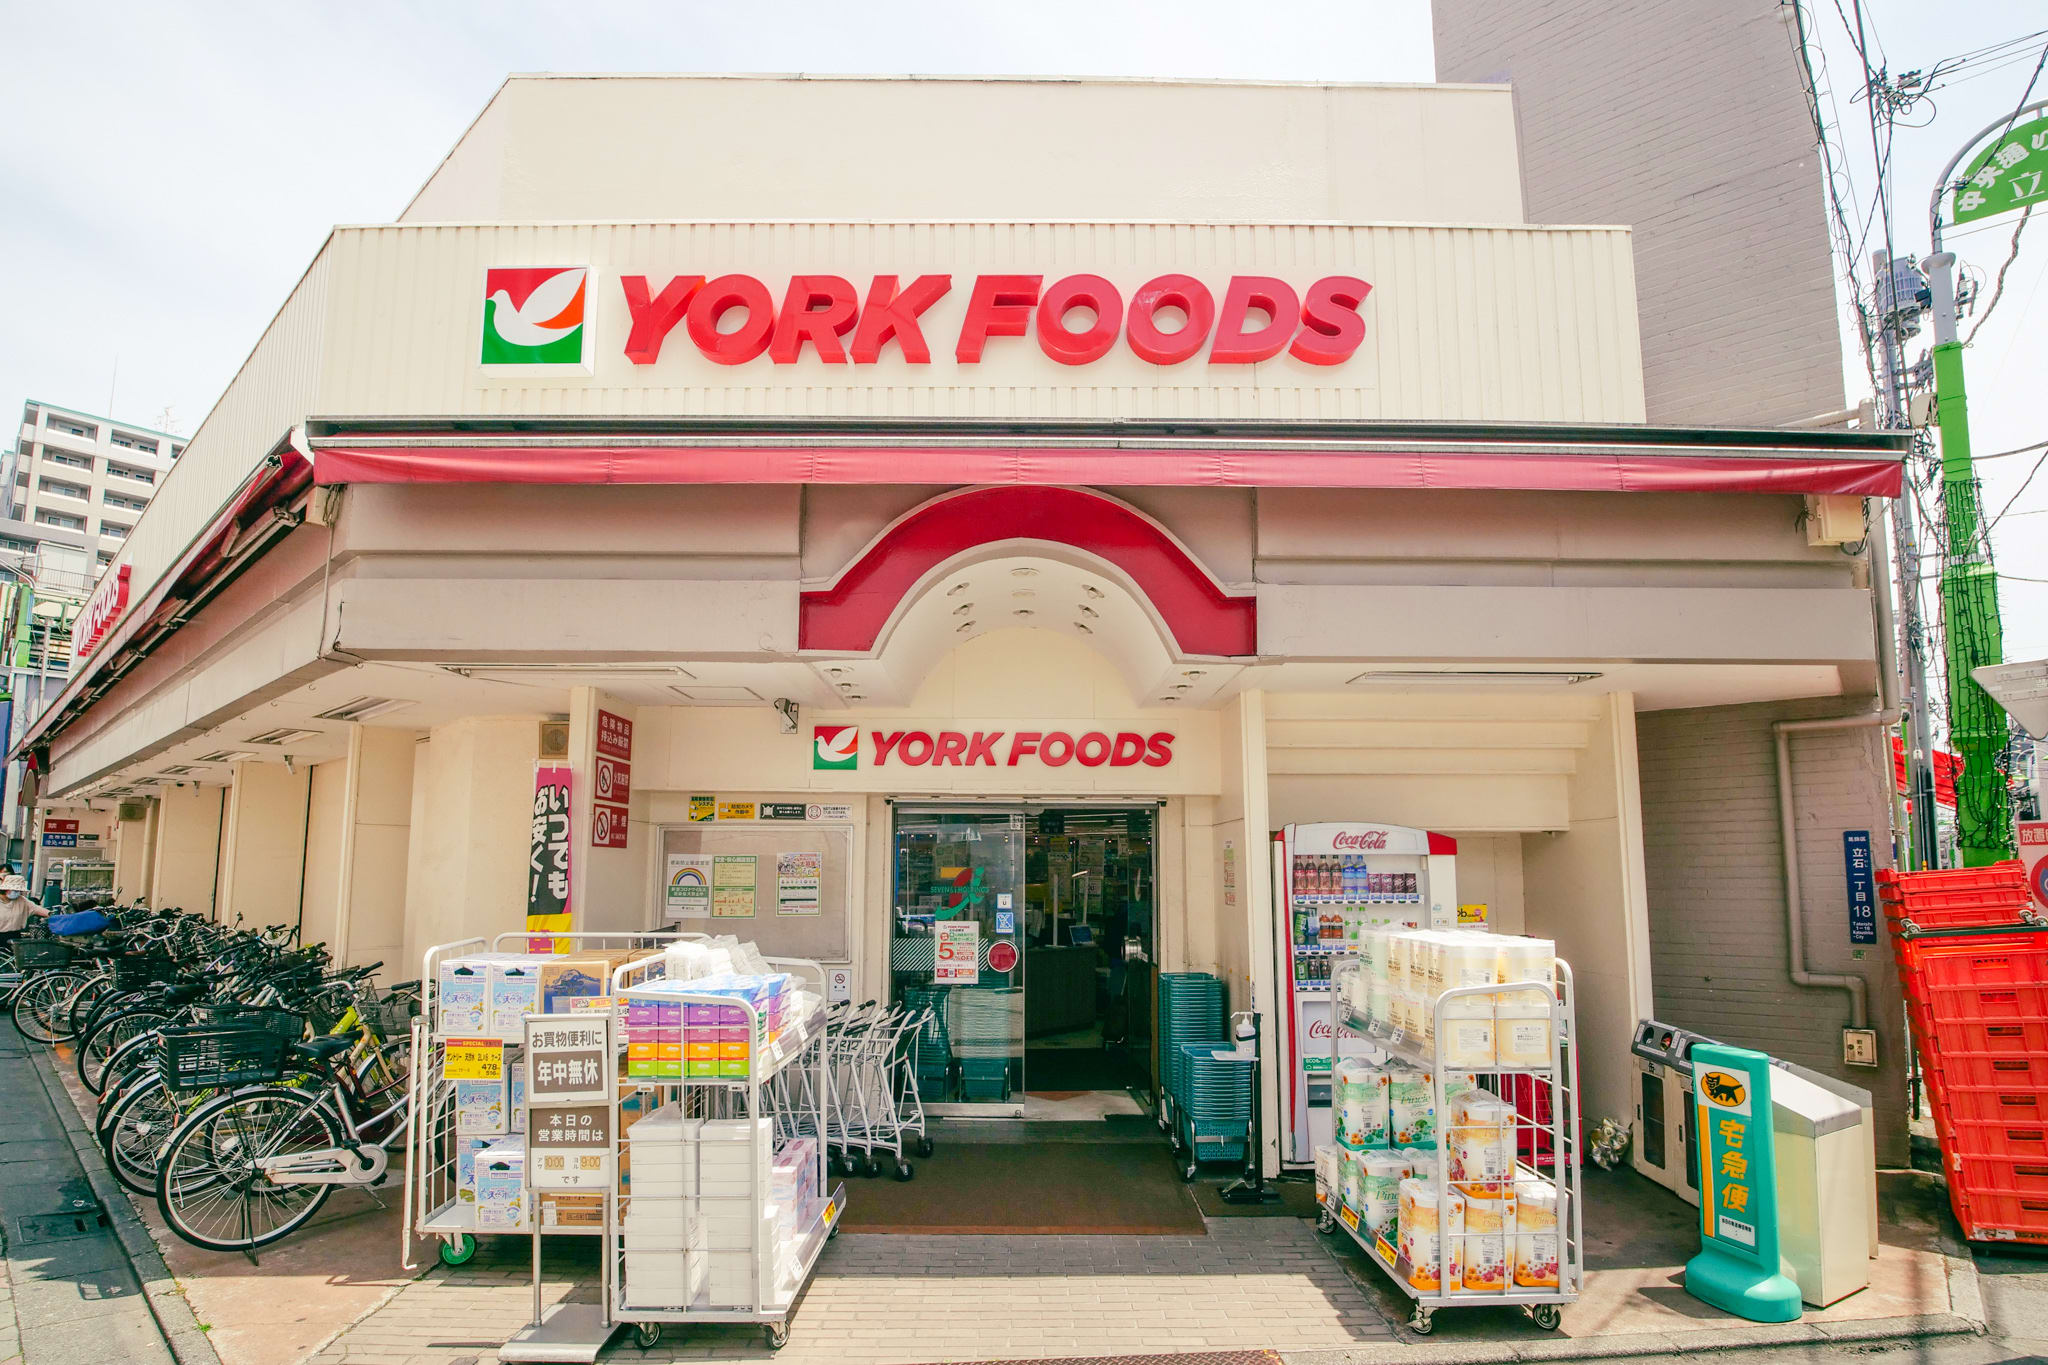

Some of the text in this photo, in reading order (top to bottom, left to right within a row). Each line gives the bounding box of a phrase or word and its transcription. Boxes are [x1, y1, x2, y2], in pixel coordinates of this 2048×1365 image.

[620, 274, 1374, 366] YORK FOODS
[871, 731, 1176, 768] YORK FOODS
[548, 784, 570, 900] いつでも
[1332, 830, 1389, 850] Coca-Cola
[2021, 826, 2048, 843] 放置
[1852, 848, 1866, 902] 立石一丁目
[1853, 905, 1872, 918] 18
[938, 942, 954, 960] 5
[532, 1031, 603, 1048] お買物便利に
[537, 1058, 599, 1087] 年中無休
[549, 1114, 592, 1127] 本日の
[538, 1129, 604, 1142] 営業時間は
[573, 1157, 579, 1170] ヨル
[581, 1157, 601, 1168] 9:00
[1718, 1119, 1750, 1213] 宅急便
[561, 1175, 580, 1185] です
